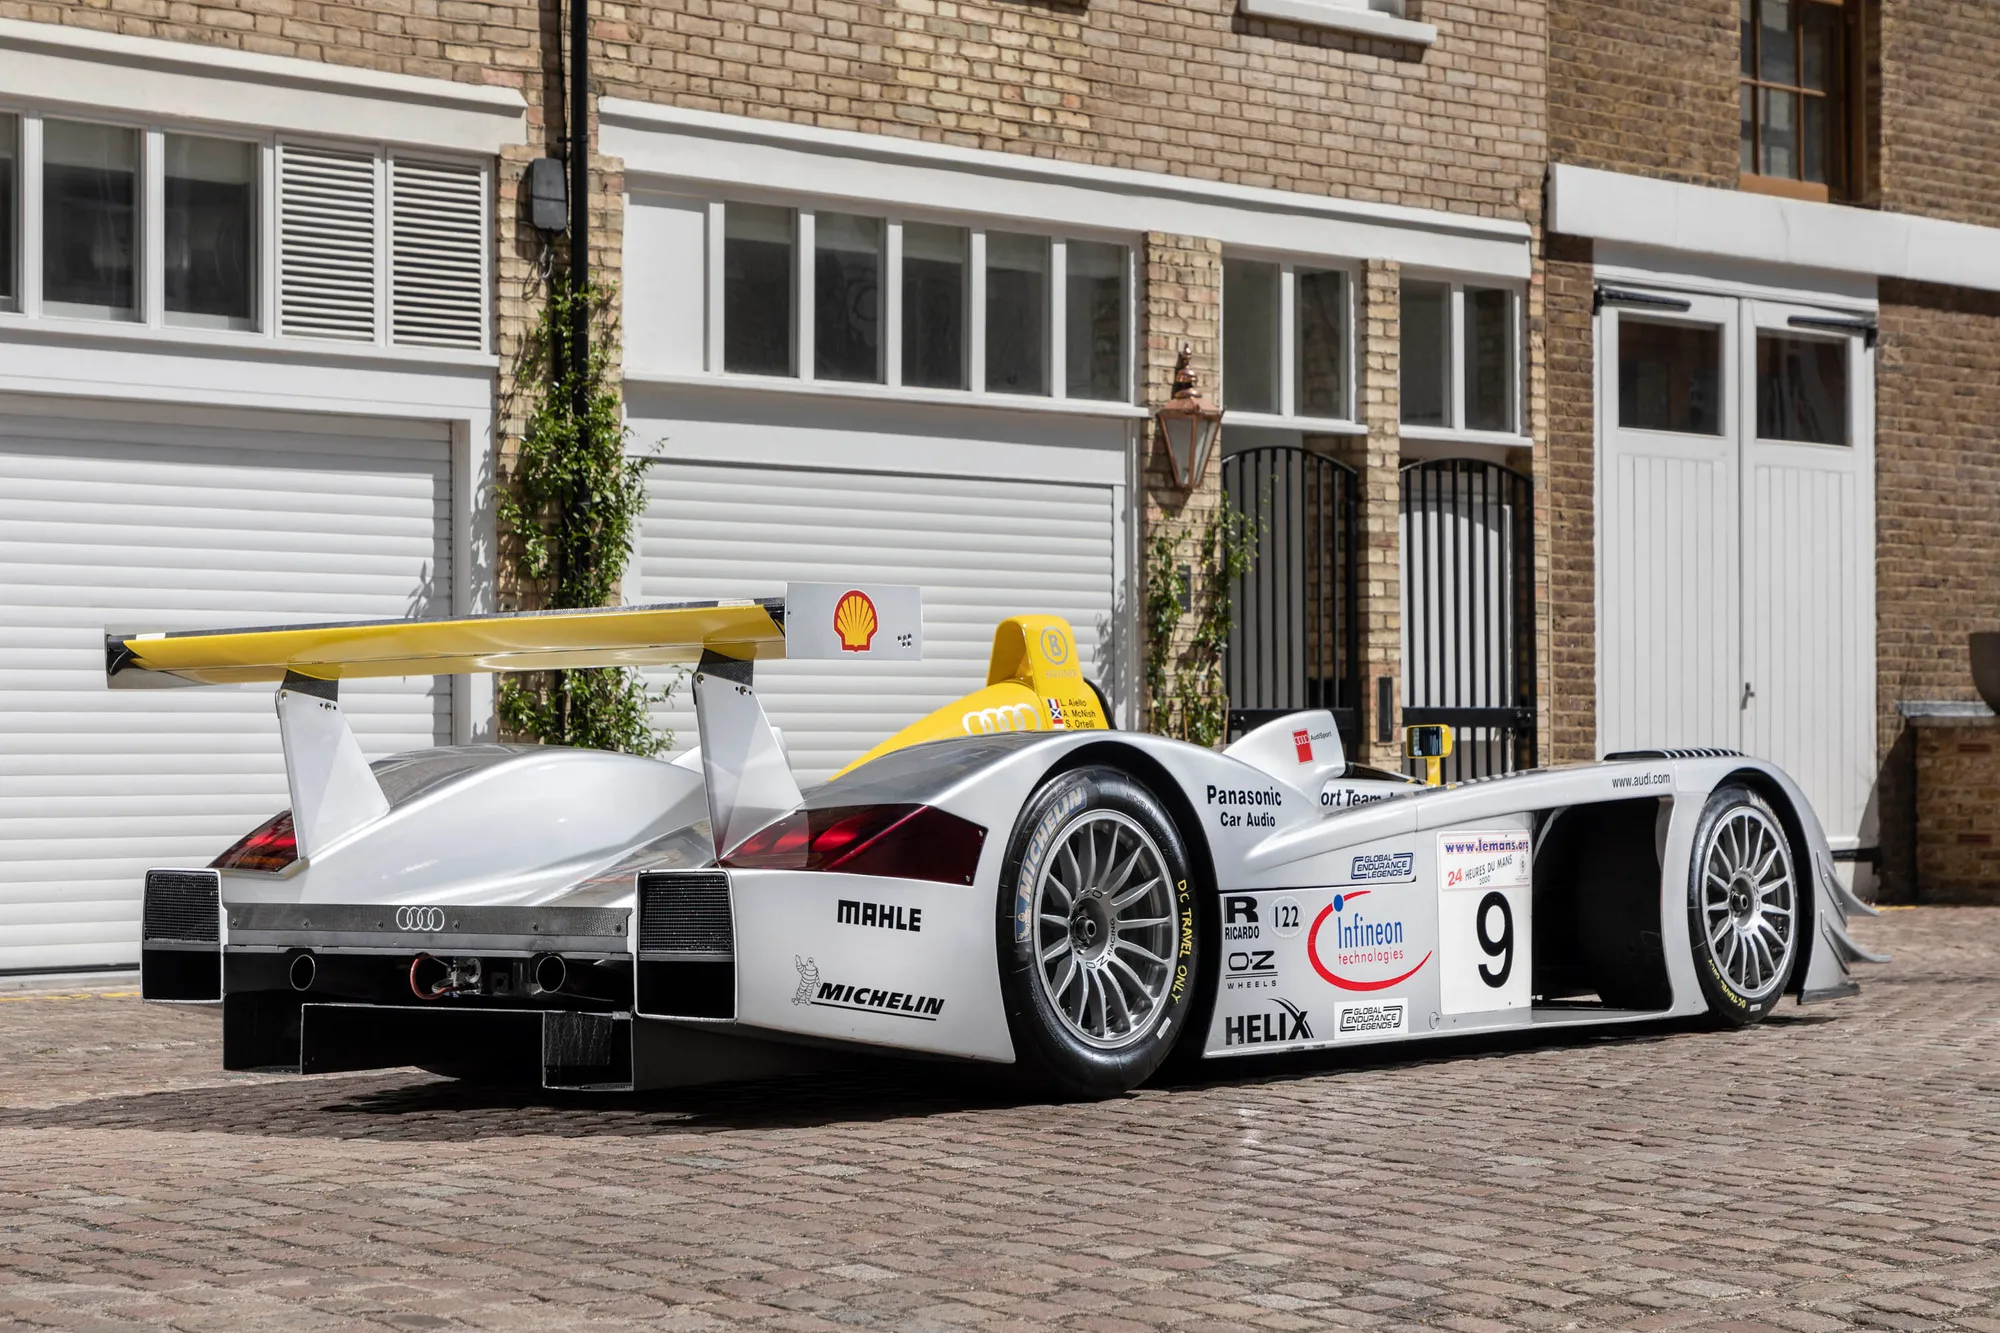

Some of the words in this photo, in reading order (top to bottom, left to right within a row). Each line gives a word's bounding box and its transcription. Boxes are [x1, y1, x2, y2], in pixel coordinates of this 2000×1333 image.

[1069, 698, 1087, 706] Aiello
[1072, 709, 1096, 718] McNish
[1065, 720, 1073, 728] S.
[1075, 719, 1095, 728] Ortelli
[1612, 772, 1671, 789] www.audi.com
[1206, 785, 1282, 807] Panasonic
[1220, 812, 1242, 828] Car
[1246, 812, 1276, 828] Audio
[1018, 786, 1083, 903] MICHELIN
[1357, 861, 1408, 872] ENDURANCE
[1364, 853, 1393, 864] GLOBAL
[1367, 869, 1403, 879] LEGENDS
[1447, 868, 1463, 887] 24
[1465, 864, 1486, 881] HEURES
[1487, 861, 1496, 873] DU
[1497, 854, 1513, 869] MANS
[1177, 879, 1190, 903] DC
[837, 899, 922, 932] MAHLE
[1224, 896, 1259, 924] R
[1107, 917, 1115, 956] RACING
[1178, 907, 1192, 959] TRAVEL
[1224, 926, 1260, 940] RICARDO
[1337, 912, 1403, 949] Infineon
[1476, 891, 1514, 988] 9
[1338, 947, 1404, 965] technologies
[1171, 964, 1188, 1004] ONLY
[1227, 979, 1277, 990] WHEELS
[816, 982, 945, 1015] MICHELIN
[1346, 1013, 1397, 1024] ENDURANCE
[1353, 1006, 1383, 1016] GLOBAL
[1225, 1007, 1315, 1046] HELIX
[1356, 1021, 1393, 1031] LEGENDS
